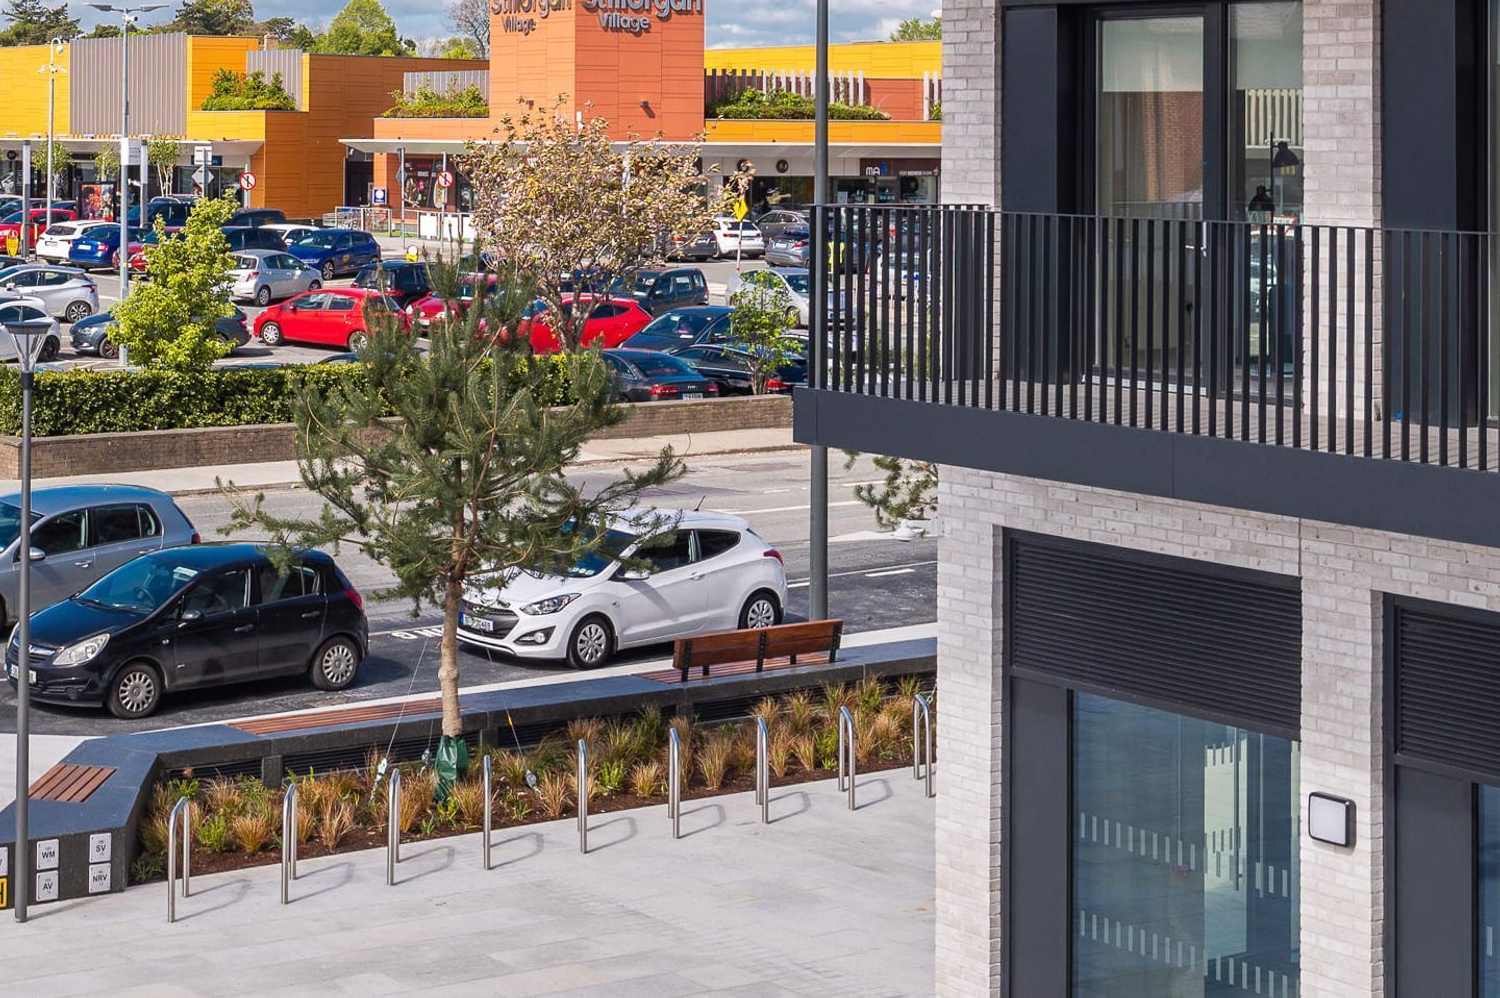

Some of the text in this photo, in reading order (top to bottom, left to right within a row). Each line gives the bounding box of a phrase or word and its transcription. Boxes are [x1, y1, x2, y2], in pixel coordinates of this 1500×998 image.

[501, 15, 537, 34] Village
[598, 12, 650, 34] Village
[96, 844, 106, 853] SV
[41, 851, 56, 859] WM
[92, 874, 107, 882] NRV
[42, 882, 53, 890] AV
